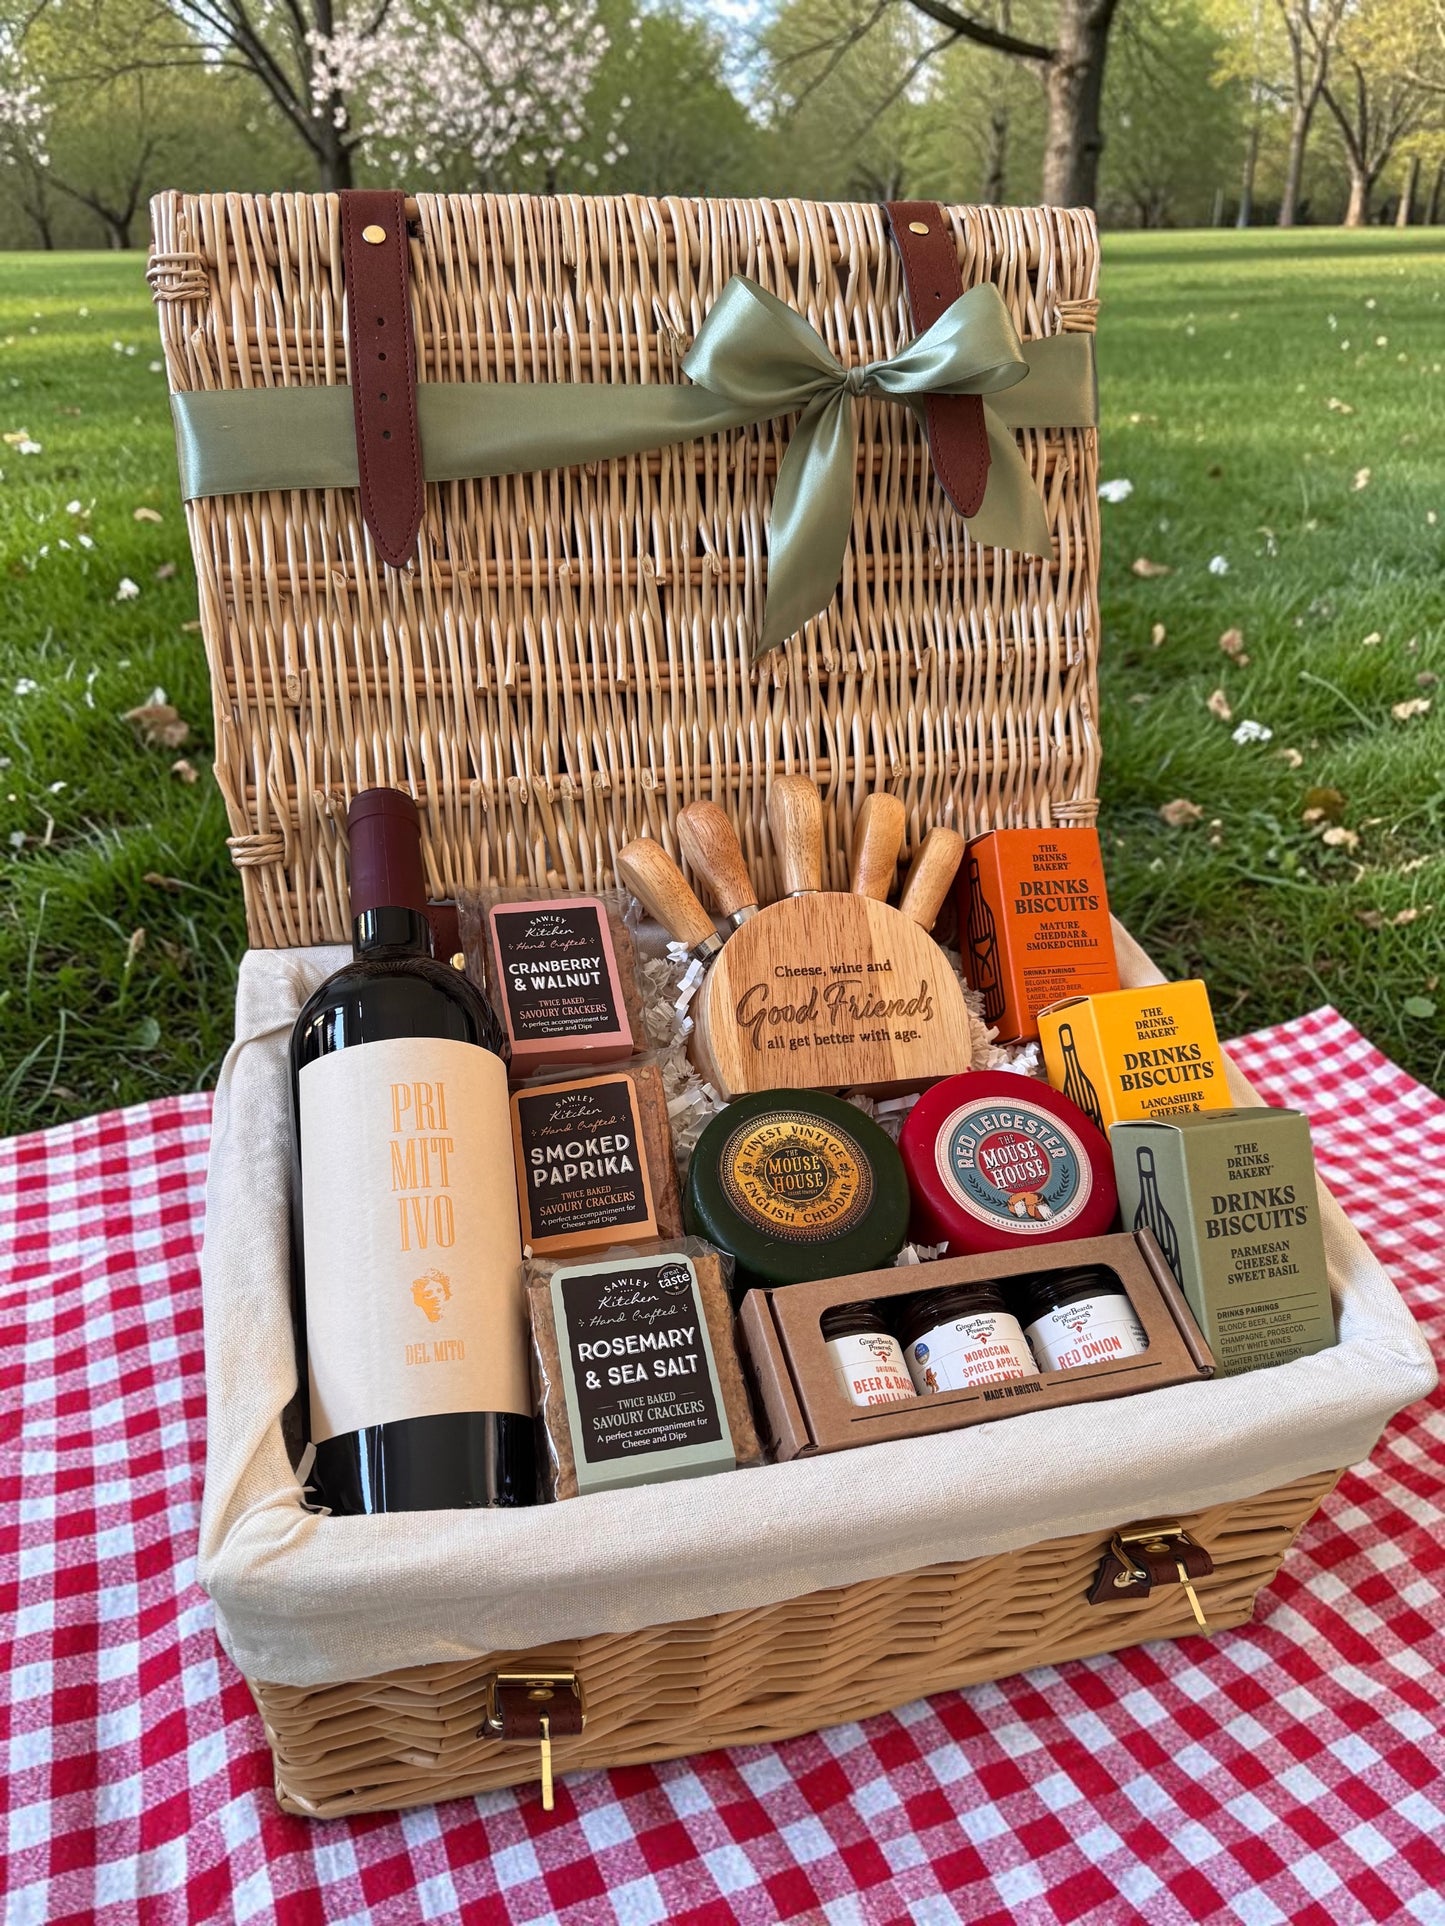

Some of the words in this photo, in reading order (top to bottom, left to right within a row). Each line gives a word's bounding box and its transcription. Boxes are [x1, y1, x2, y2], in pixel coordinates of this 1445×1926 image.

[1033, 853, 1067, 862] DRINKS
[1038, 845, 1058, 853] THE
[1020, 879, 1089, 897] DRINKS
[1015, 895, 1099, 915] BISCUITS
[530, 916, 567, 926] SAWLEY
[1040, 921, 1079, 931] MATURE
[525, 926, 574, 938] Kitchen
[1034, 931, 1080, 940] CHEDDAR
[1081, 930, 1088, 938] &
[516, 941, 546, 950] Hand
[550, 938, 587, 951] Crafted
[1026, 941, 1067, 951] SMOKED
[1067, 939, 1098, 948] CHILLI
[509, 957, 600, 974] CRANBERRY
[774, 966, 827, 977] Cheese,
[830, 962, 863, 975] wine
[867, 960, 892, 972] and
[514, 978, 527, 991] &
[531, 972, 600, 990] WALNUT
[539, 999, 560, 1007] TWICE
[562, 997, 584, 1005] BAKED
[520, 1008, 559, 1019] SAVOURY
[562, 1004, 607, 1016] CRACKERS
[736, 983, 818, 1050] Good
[823, 980, 933, 1026] Friends
[1141, 1007, 1163, 1018] THE
[529, 1020, 549, 1028] perfect
[551, 1016, 598, 1025] accompaniment
[1135, 1016, 1174, 1029] DRINKS
[767, 1036, 784, 1049] all
[789, 1036, 810, 1050] get
[815, 1034, 855, 1046] better
[859, 1029, 890, 1042] with
[895, 1030, 921, 1041] age.
[1123, 1044, 1202, 1071] DRINKS
[1120, 1062, 1214, 1091] BISCUITS
[390, 1082, 448, 1133] PRI
[556, 1096, 595, 1108] SAWLEY
[1141, 1091, 1204, 1110] LANCASHIRE
[550, 1107, 602, 1121] Kitchen
[1150, 1105, 1191, 1117] CHEESE
[1192, 1104, 1200, 1112] &
[541, 1125, 573, 1136] Hand
[578, 1117, 617, 1133] Crafted
[744, 1127, 783, 1157] FINEST
[791, 1126, 846, 1159] VINTAGE
[957, 1134, 976, 1168] RED
[970, 1113, 1067, 1159] LEICESTER
[998, 1134, 1015, 1145] THE
[1234, 1143, 1258, 1154] THE
[531, 1134, 630, 1165] SMOKED
[981, 1140, 1038, 1170] MOUSE
[389, 1137, 453, 1191] MIT
[769, 1155, 821, 1175] MOUSE
[1227, 1153, 1269, 1168] DRINKS
[533, 1155, 634, 1188] PAPRIKA
[991, 1159, 1047, 1190] HOUSE
[773, 1172, 823, 1193] HOUSE
[561, 1190, 584, 1200] TWICE
[587, 1185, 611, 1196] BAKED
[1211, 1185, 1296, 1215] DRINKS
[540, 1200, 583, 1216] SAVOURY
[586, 1191, 635, 1208] CRACKERS
[745, 1182, 795, 1222] ENGLISH
[803, 1183, 851, 1223] CHEDDAR
[398, 1195, 455, 1251] IVO
[548, 1216, 571, 1226] perfect
[572, 1207, 623, 1222] accompaniment
[562, 1221, 586, 1229] Cheese
[602, 1216, 617, 1225] Dips
[1205, 1206, 1307, 1239] BISCUITS
[1231, 1240, 1290, 1259] PARMESAN
[1235, 1255, 1279, 1271] CHEESE
[1281, 1253, 1289, 1264] &
[658, 1273, 690, 1288] taste
[663, 1268, 679, 1278] great
[1228, 1269, 1266, 1284] SWEET
[1268, 1264, 1299, 1278] BASIL
[604, 1279, 649, 1292] SAWLEY
[599, 1292, 659, 1310] Kitchen
[590, 1313, 627, 1326] Hand
[632, 1305, 678, 1325] Crafted
[1217, 1308, 1244, 1319] DRINKS
[1245, 1303, 1279, 1314] PAIRINGS
[1219, 1321, 1247, 1332] BLONDE
[1249, 1318, 1268, 1328] BEER,
[1270, 1314, 1291, 1324] LAGER
[1074, 1333, 1093, 1344] SWEET
[1220, 1331, 1266, 1345] CHAMPAGNE,
[1267, 1324, 1306, 1337] PROSECCO,
[405, 1344, 429, 1365] DEL
[434, 1340, 465, 1362] MITO
[578, 1327, 695, 1362] ROSEMARY
[1057, 1350, 1081, 1369] RED
[1083, 1336, 1122, 1359] ONION
[1221, 1344, 1245, 1354] FRUITY
[1247, 1340, 1268, 1350] WHITE
[1270, 1336, 1291, 1346] WINES
[964, 1345, 1010, 1363] MOROCCAN
[1223, 1356, 1252, 1367] LIGHTER
[1254, 1352, 1274, 1361] STYLE
[585, 1370, 602, 1390] &
[608, 1363, 649, 1386] SEA
[654, 1355, 698, 1378] SALT
[963, 1361, 994, 1378] SPICED
[996, 1357, 1020, 1368] APPLE
[1224, 1365, 1251, 1376] WHISKY
[854, 1377, 884, 1394] BEER
[885, 1376, 894, 1389] &
[983, 1388, 1004, 1401] MADE
[1005, 1387, 1013, 1397] IN
[1015, 1382, 1043, 1395] BRISTOL
[617, 1397, 645, 1410] TWICE
[648, 1392, 675, 1404] BAKED
[593, 1410, 643, 1430] SAVOURY
[647, 1400, 705, 1421] CRACKERS
[597, 1435, 604, 1443] A
[605, 1430, 633, 1442] perfect
[634, 1420, 695, 1437] accompaniment
[622, 1439, 650, 1449] Cheese
[652, 1435, 667, 1444] and
[669, 1432, 687, 1443] Dips
